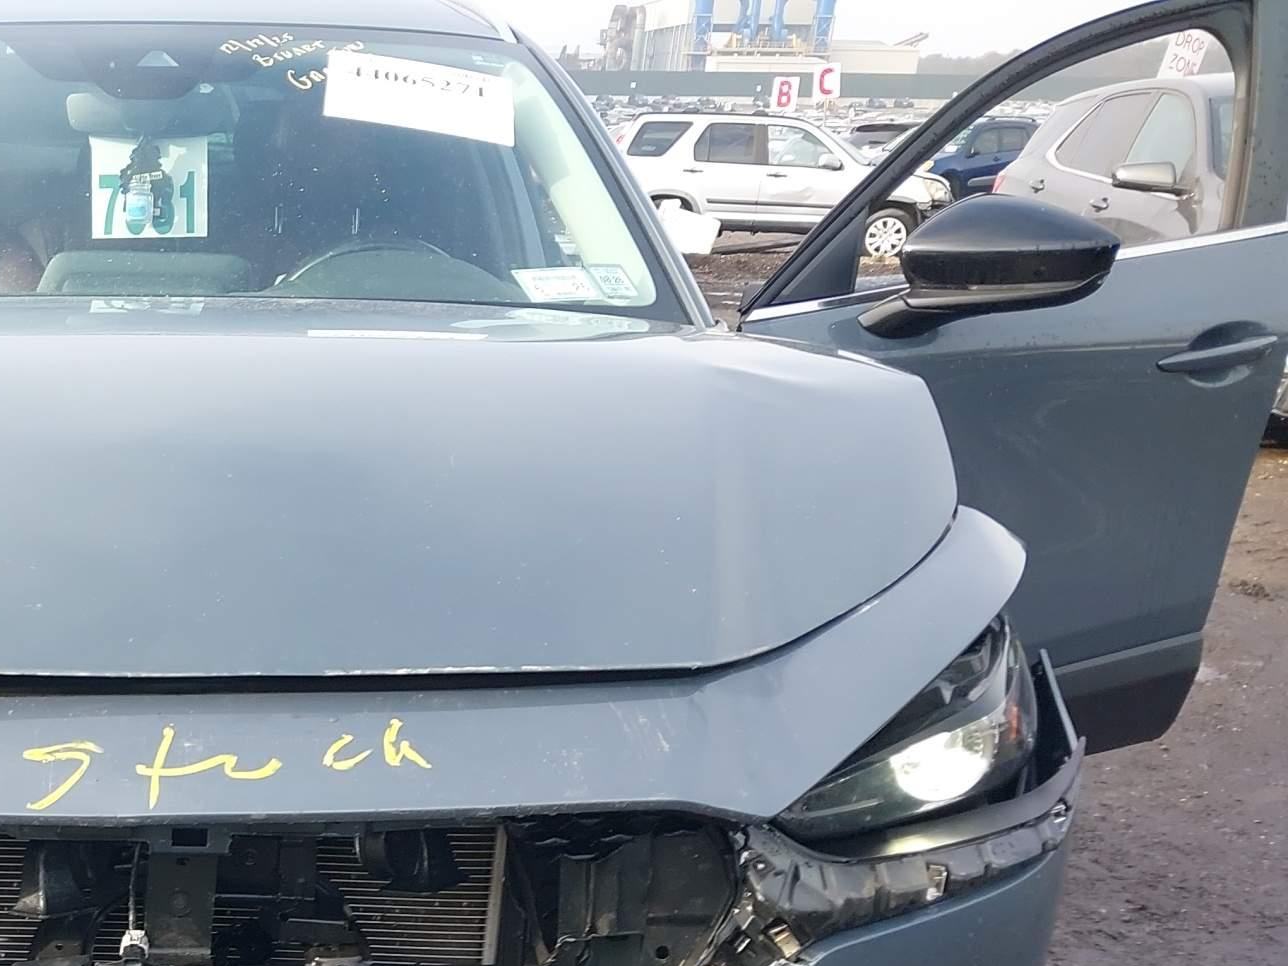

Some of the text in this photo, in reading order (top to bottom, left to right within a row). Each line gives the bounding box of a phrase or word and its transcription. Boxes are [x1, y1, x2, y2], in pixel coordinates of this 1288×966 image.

[1175, 31, 1206, 55] DROP
[776, 80, 792, 108] B
[819, 67, 835, 95] C
[98, 170, 195, 236] 71
